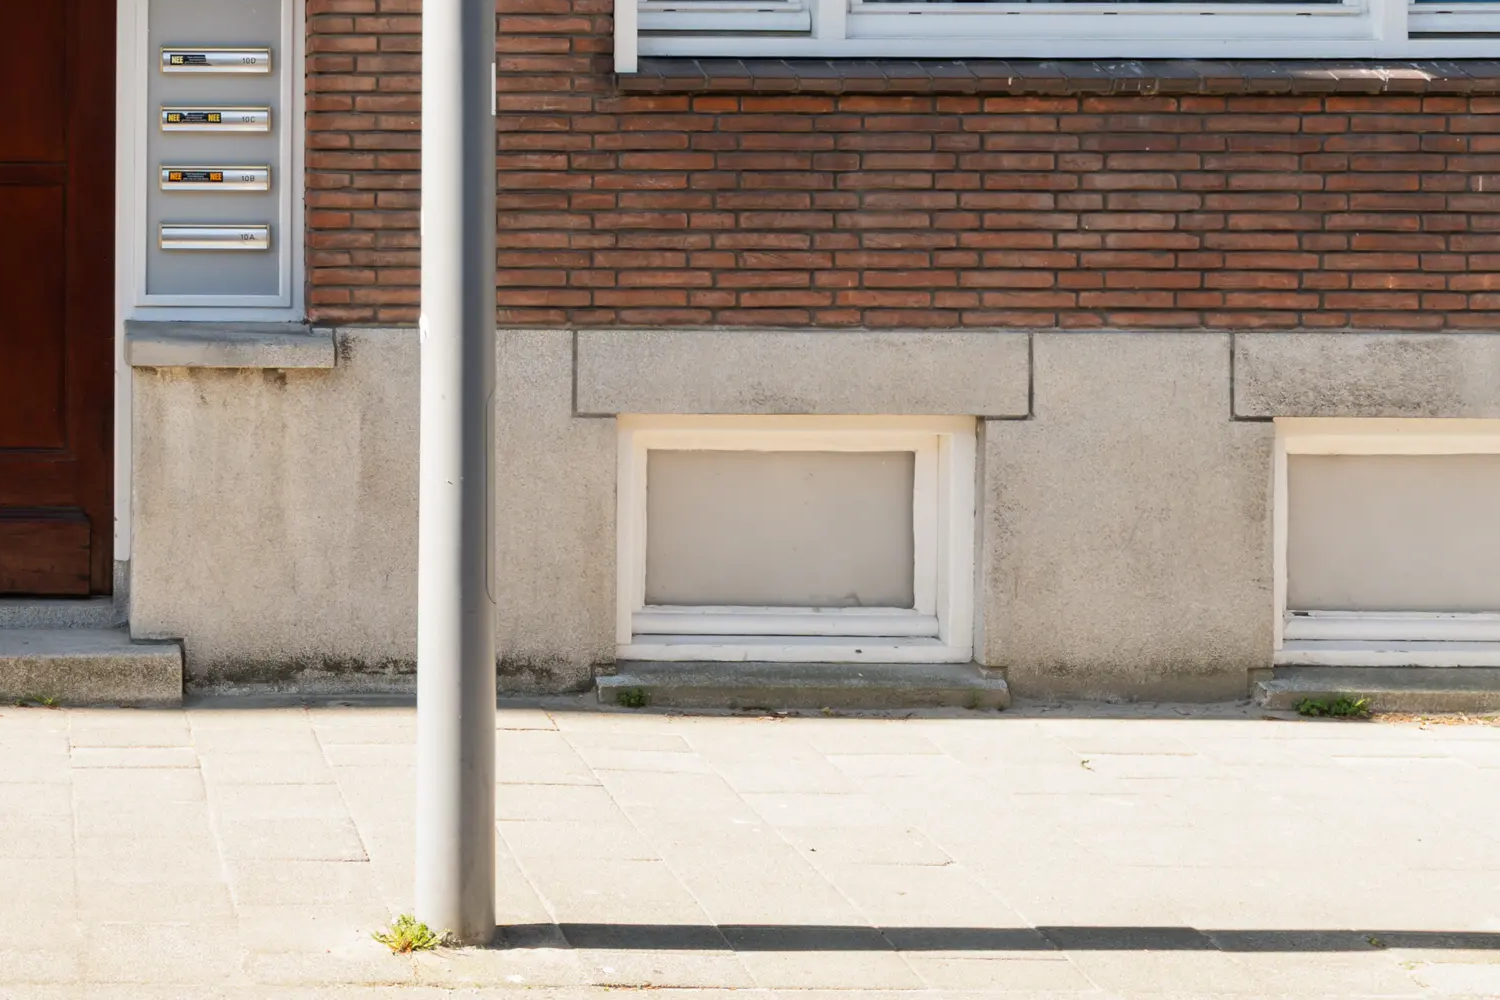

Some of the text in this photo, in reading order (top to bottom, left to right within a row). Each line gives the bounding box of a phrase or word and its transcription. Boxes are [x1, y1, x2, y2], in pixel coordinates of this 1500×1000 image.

[170, 55, 183, 64] NEE
[242, 57, 257, 65] 10D
[168, 114, 181, 122] NEE
[208, 114, 220, 122] NEE
[169, 172, 182, 181] NEE
[210, 172, 222, 181] NEE
